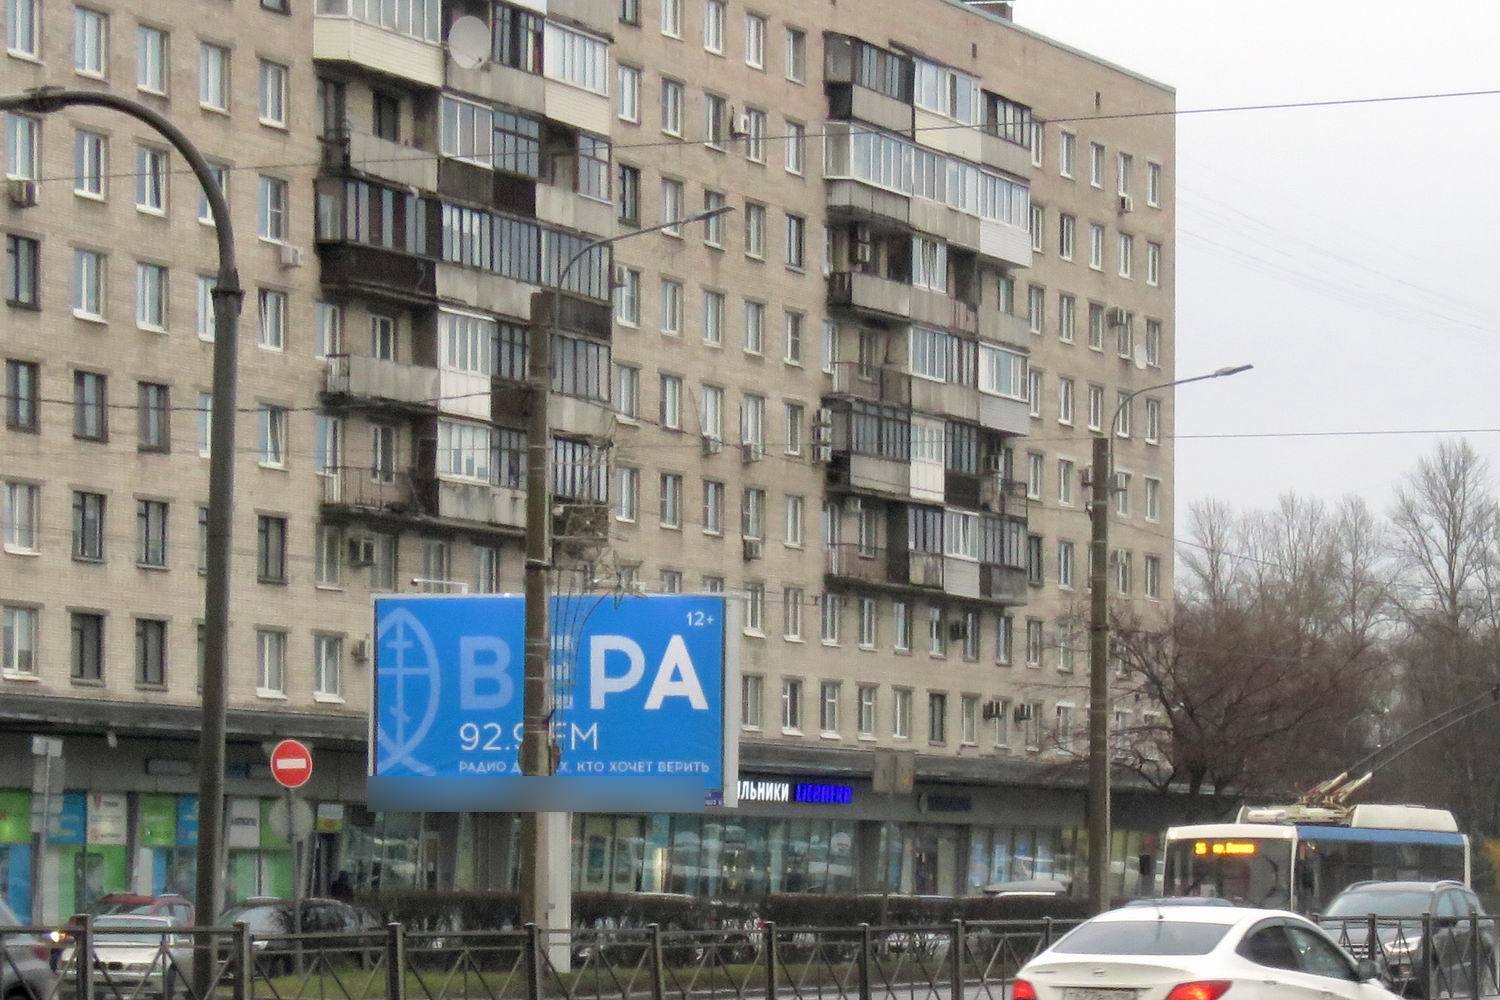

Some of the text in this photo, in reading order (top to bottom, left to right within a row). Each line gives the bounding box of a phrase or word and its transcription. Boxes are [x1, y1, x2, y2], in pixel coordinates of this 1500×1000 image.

[687, 611, 715, 627] 12+
[459, 761, 507, 774] РАДИО
[576, 761, 604, 773] КТО
[609, 761, 653, 773] ХОЧЕТ
[657, 761, 710, 773] ВЕРИТЬ
